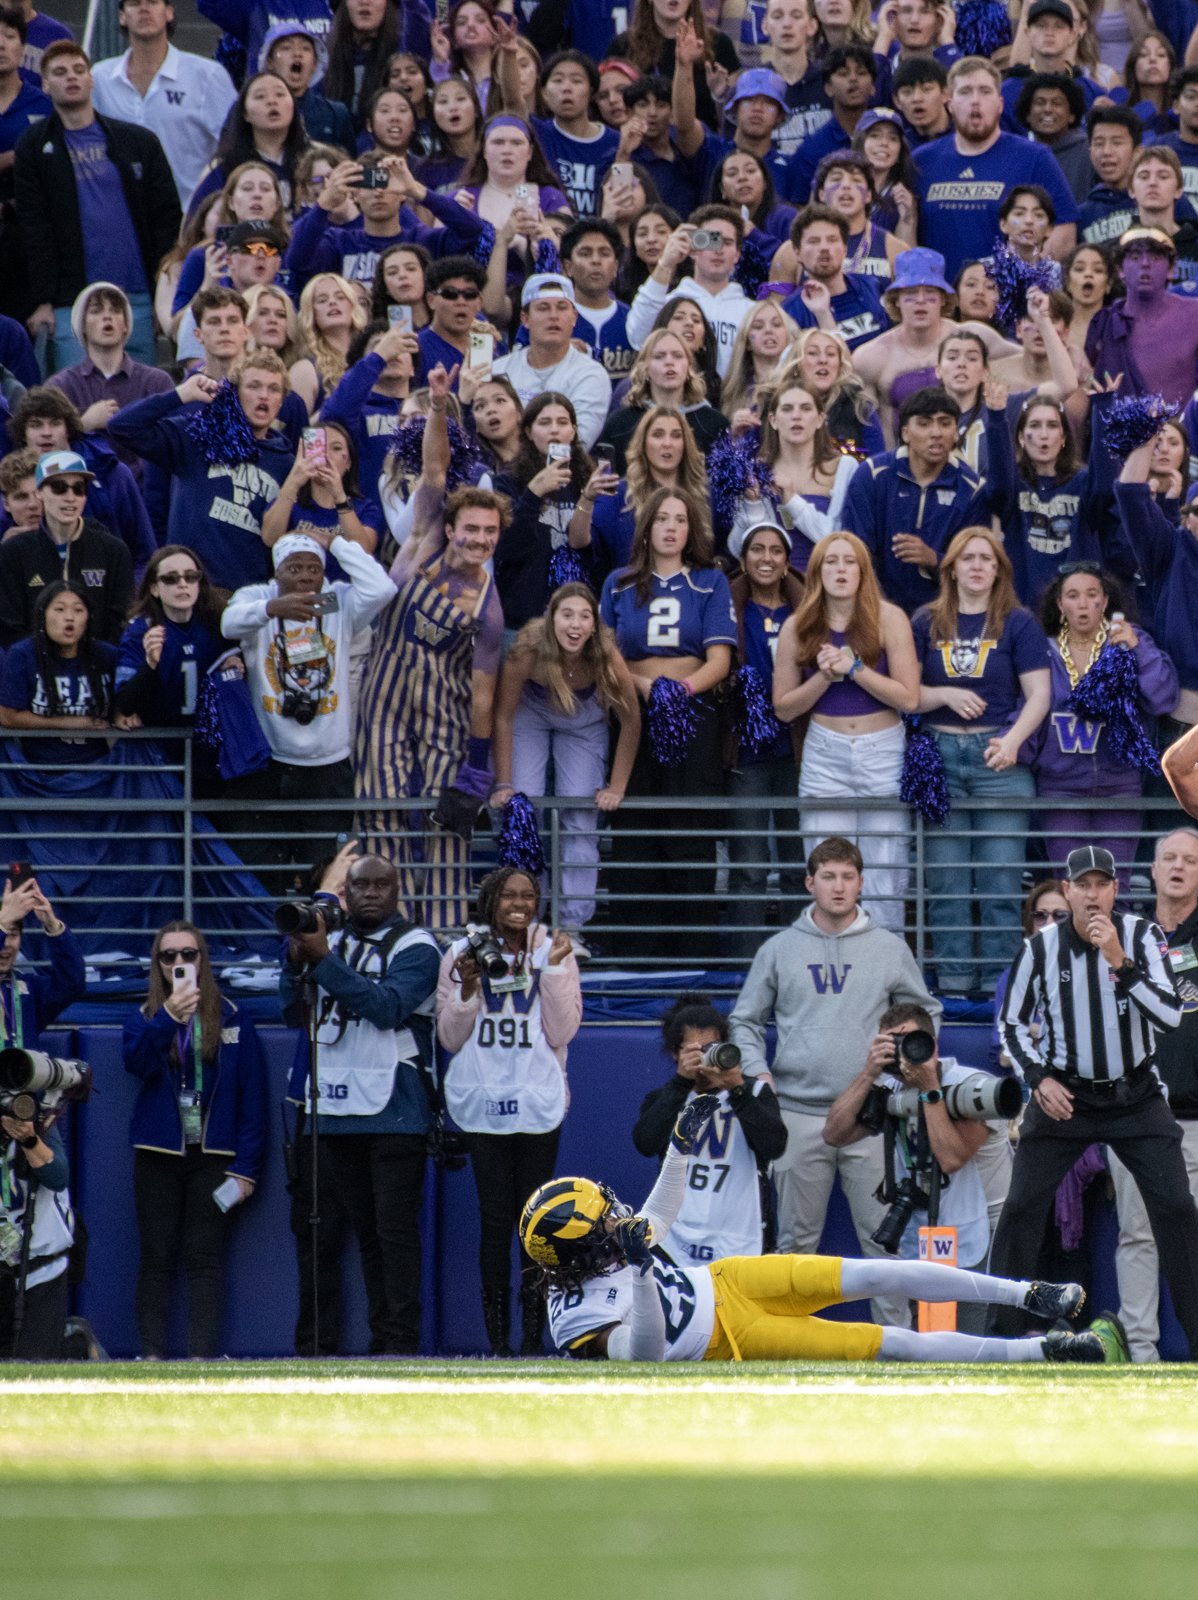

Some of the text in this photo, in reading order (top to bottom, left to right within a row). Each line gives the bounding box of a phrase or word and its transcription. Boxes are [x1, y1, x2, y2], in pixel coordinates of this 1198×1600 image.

[164, 89, 185, 106] W
[928, 182, 1005, 201] HUSKIES
[81, 568, 106, 587] W
[413, 608, 454, 645] W
[647, 597, 684, 648] 2
[1050, 713, 1106, 754] W
[806, 964, 852, 995] W
[1060, 969, 1071, 983] S
[1117, 999, 1128, 1017] F
[477, 1018, 533, 1049] 091
[686, 1163, 730, 1194] 67
[933, 1240, 954, 1255] W
